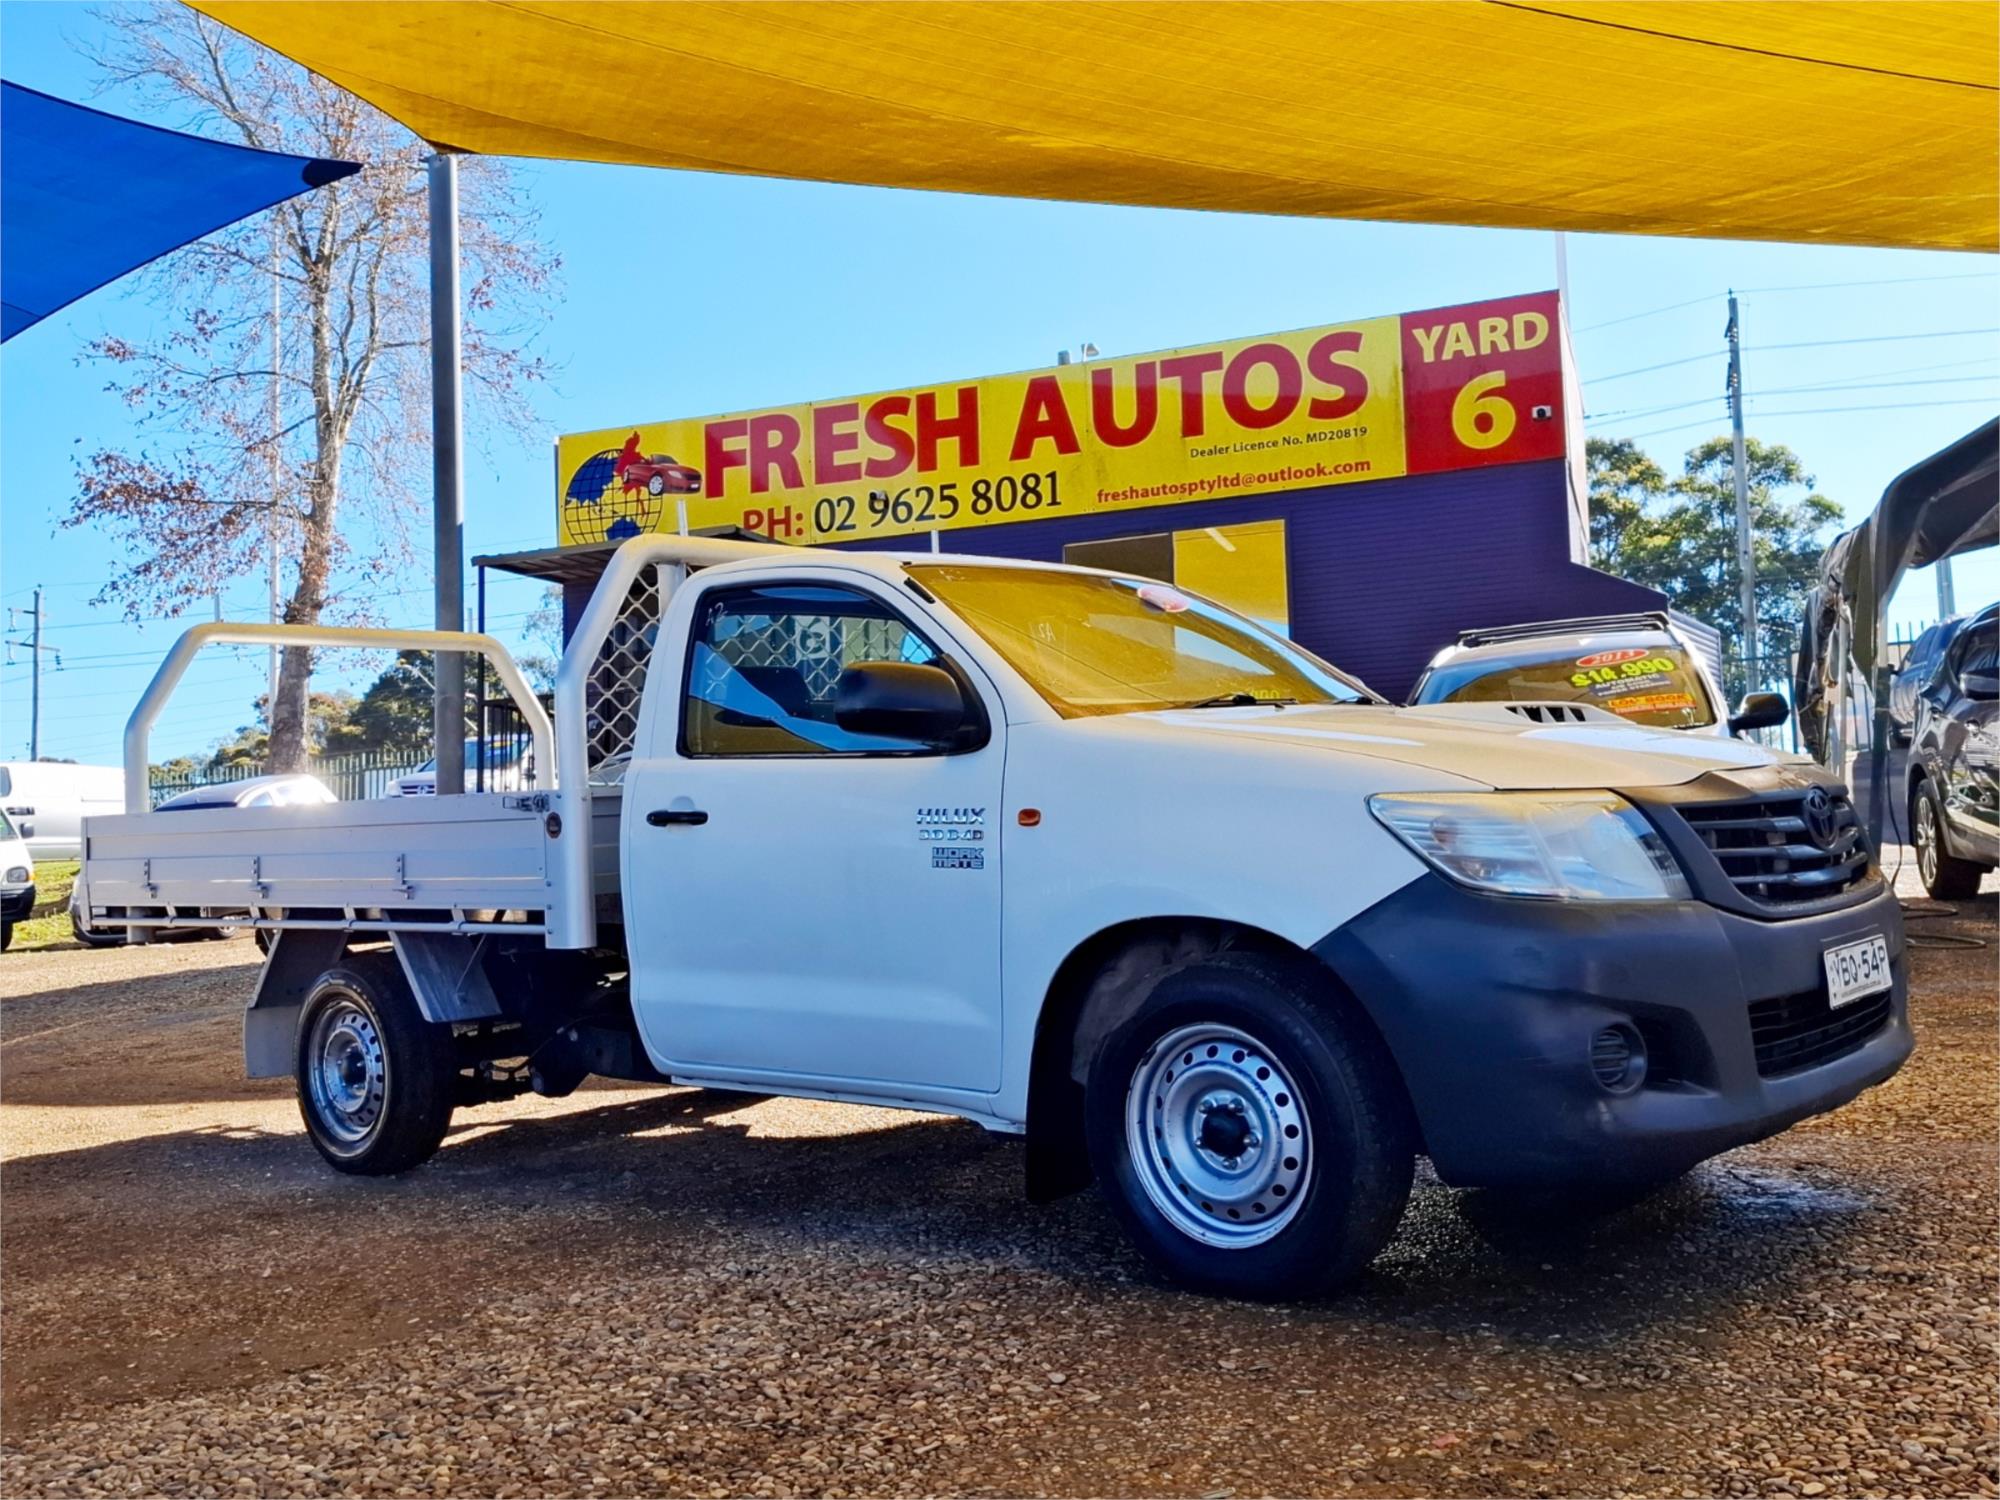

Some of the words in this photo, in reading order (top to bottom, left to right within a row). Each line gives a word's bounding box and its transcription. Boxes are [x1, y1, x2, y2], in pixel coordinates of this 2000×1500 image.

[1412, 312, 1549, 363] YARD
[705, 386, 980, 498] FRESH
[1010, 331, 1368, 460] AUTOS
[1452, 370, 1516, 449] 6
[1190, 445, 1230, 458] Dealer
[1233, 439, 1279, 453] Licence
[1282, 435, 1303, 446] No.
[1306, 426, 1368, 443] MD20819
[1097, 459, 1371, 503] freshautosptyltd@outlook.com
[743, 505, 804, 539] PH:
[814, 496, 856, 533] 02
[868, 483, 960, 528] 9625
[971, 471, 1061, 515] 8081
[916, 808, 986, 825] HILUX
[932, 847, 984, 859] WORK
[932, 859, 984, 869] MATE
